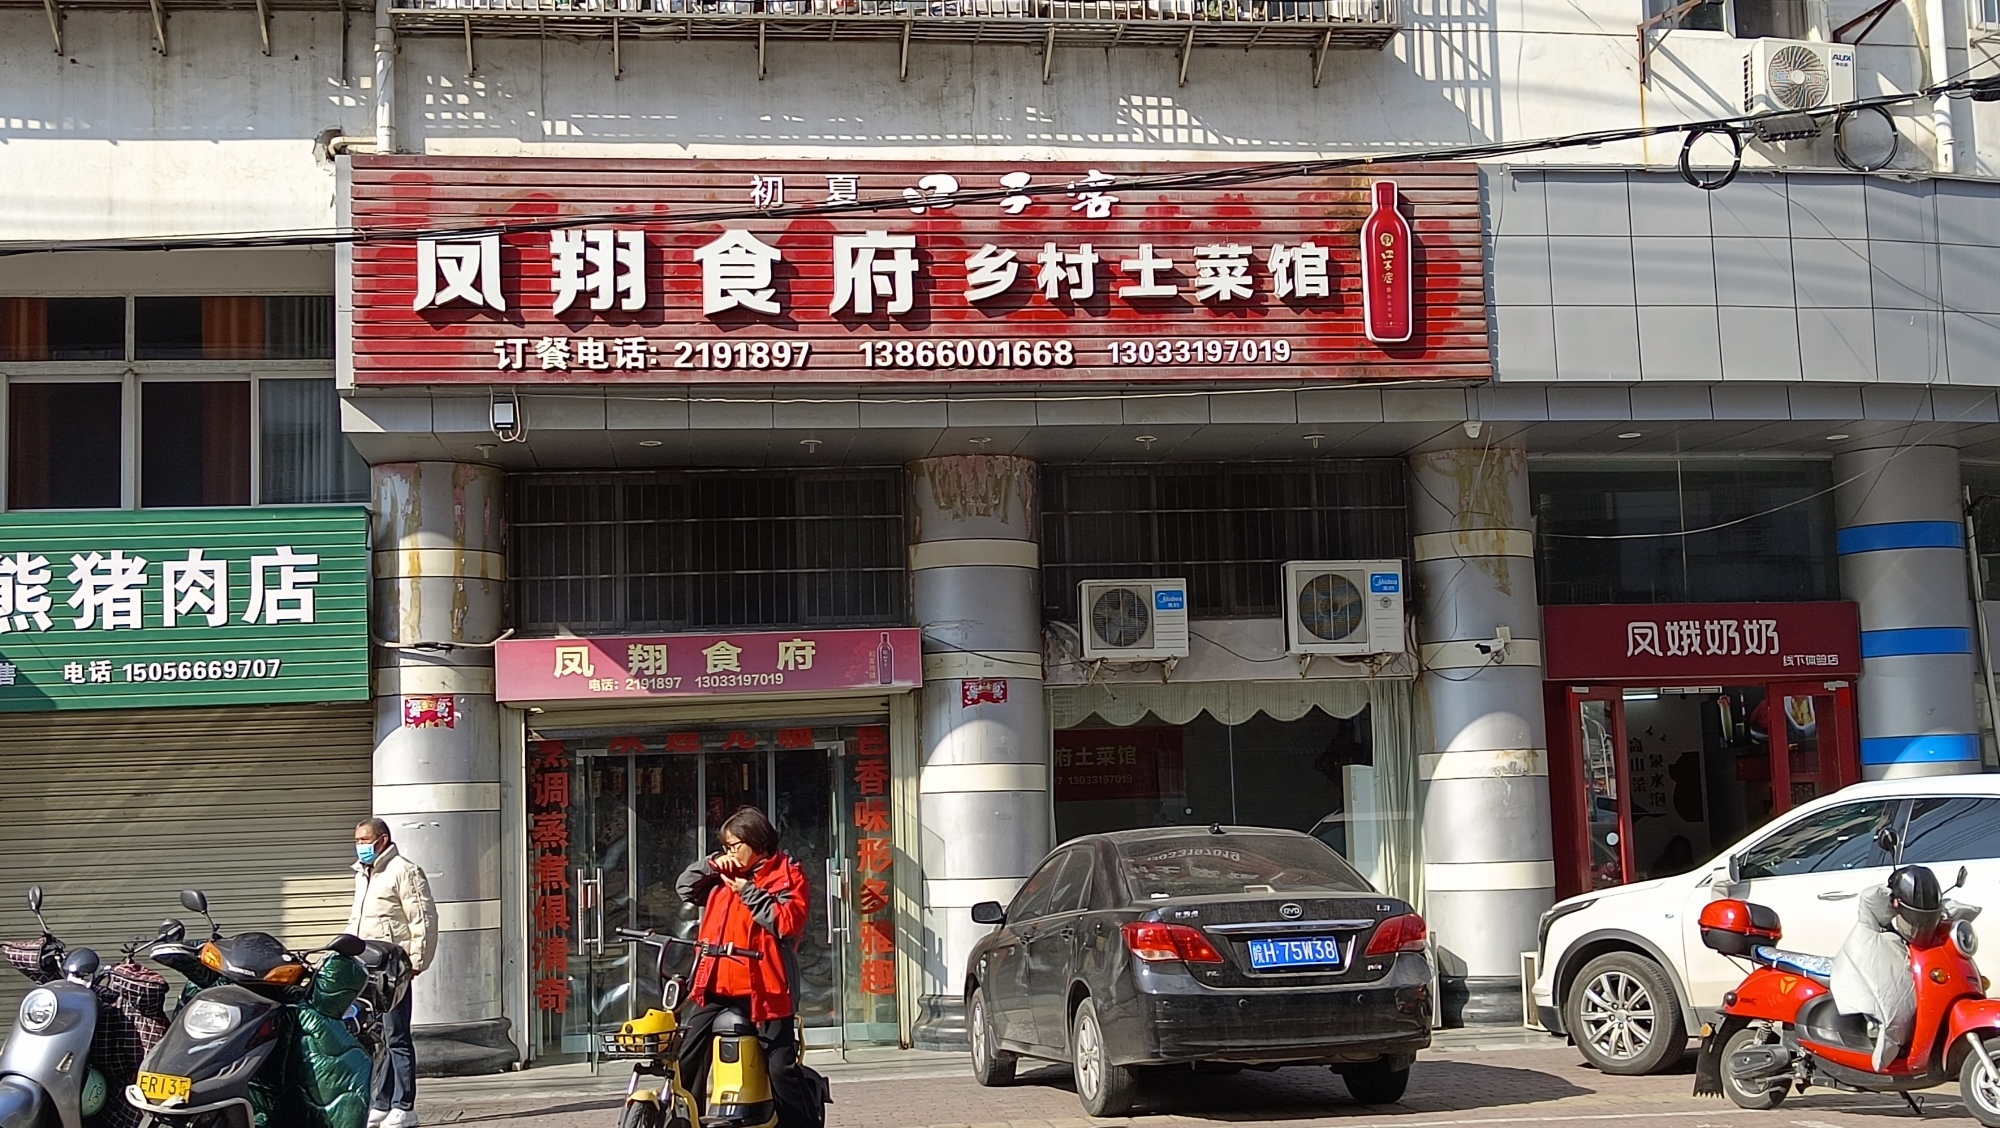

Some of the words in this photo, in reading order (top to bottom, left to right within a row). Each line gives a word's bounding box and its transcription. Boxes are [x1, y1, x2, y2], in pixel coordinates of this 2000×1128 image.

[750, 174, 860, 207] 初夏
[413, 228, 919, 316] 凤翔食府
[964, 242, 1330, 303] 乡村土菜馆
[674, 340, 810, 369] 2191897
[858, 339, 1074, 368] 13866001668
[1107, 338, 1292, 364] 13033197019
[0, 546, 320, 633] 熊猪肉店
[1626, 619, 1780, 658] 凤娥奶奶
[64, 660, 112, 684] 电话
[123, 658, 282, 682] 15056669707
[552, 638, 817, 679] 凤翔食府
[625, 675, 682, 691] 2191897
[694, 673, 784, 689] 13033197019
[1054, 745, 1138, 767] 府土菜馆
[1068, 773, 1134, 786] 13033197019
